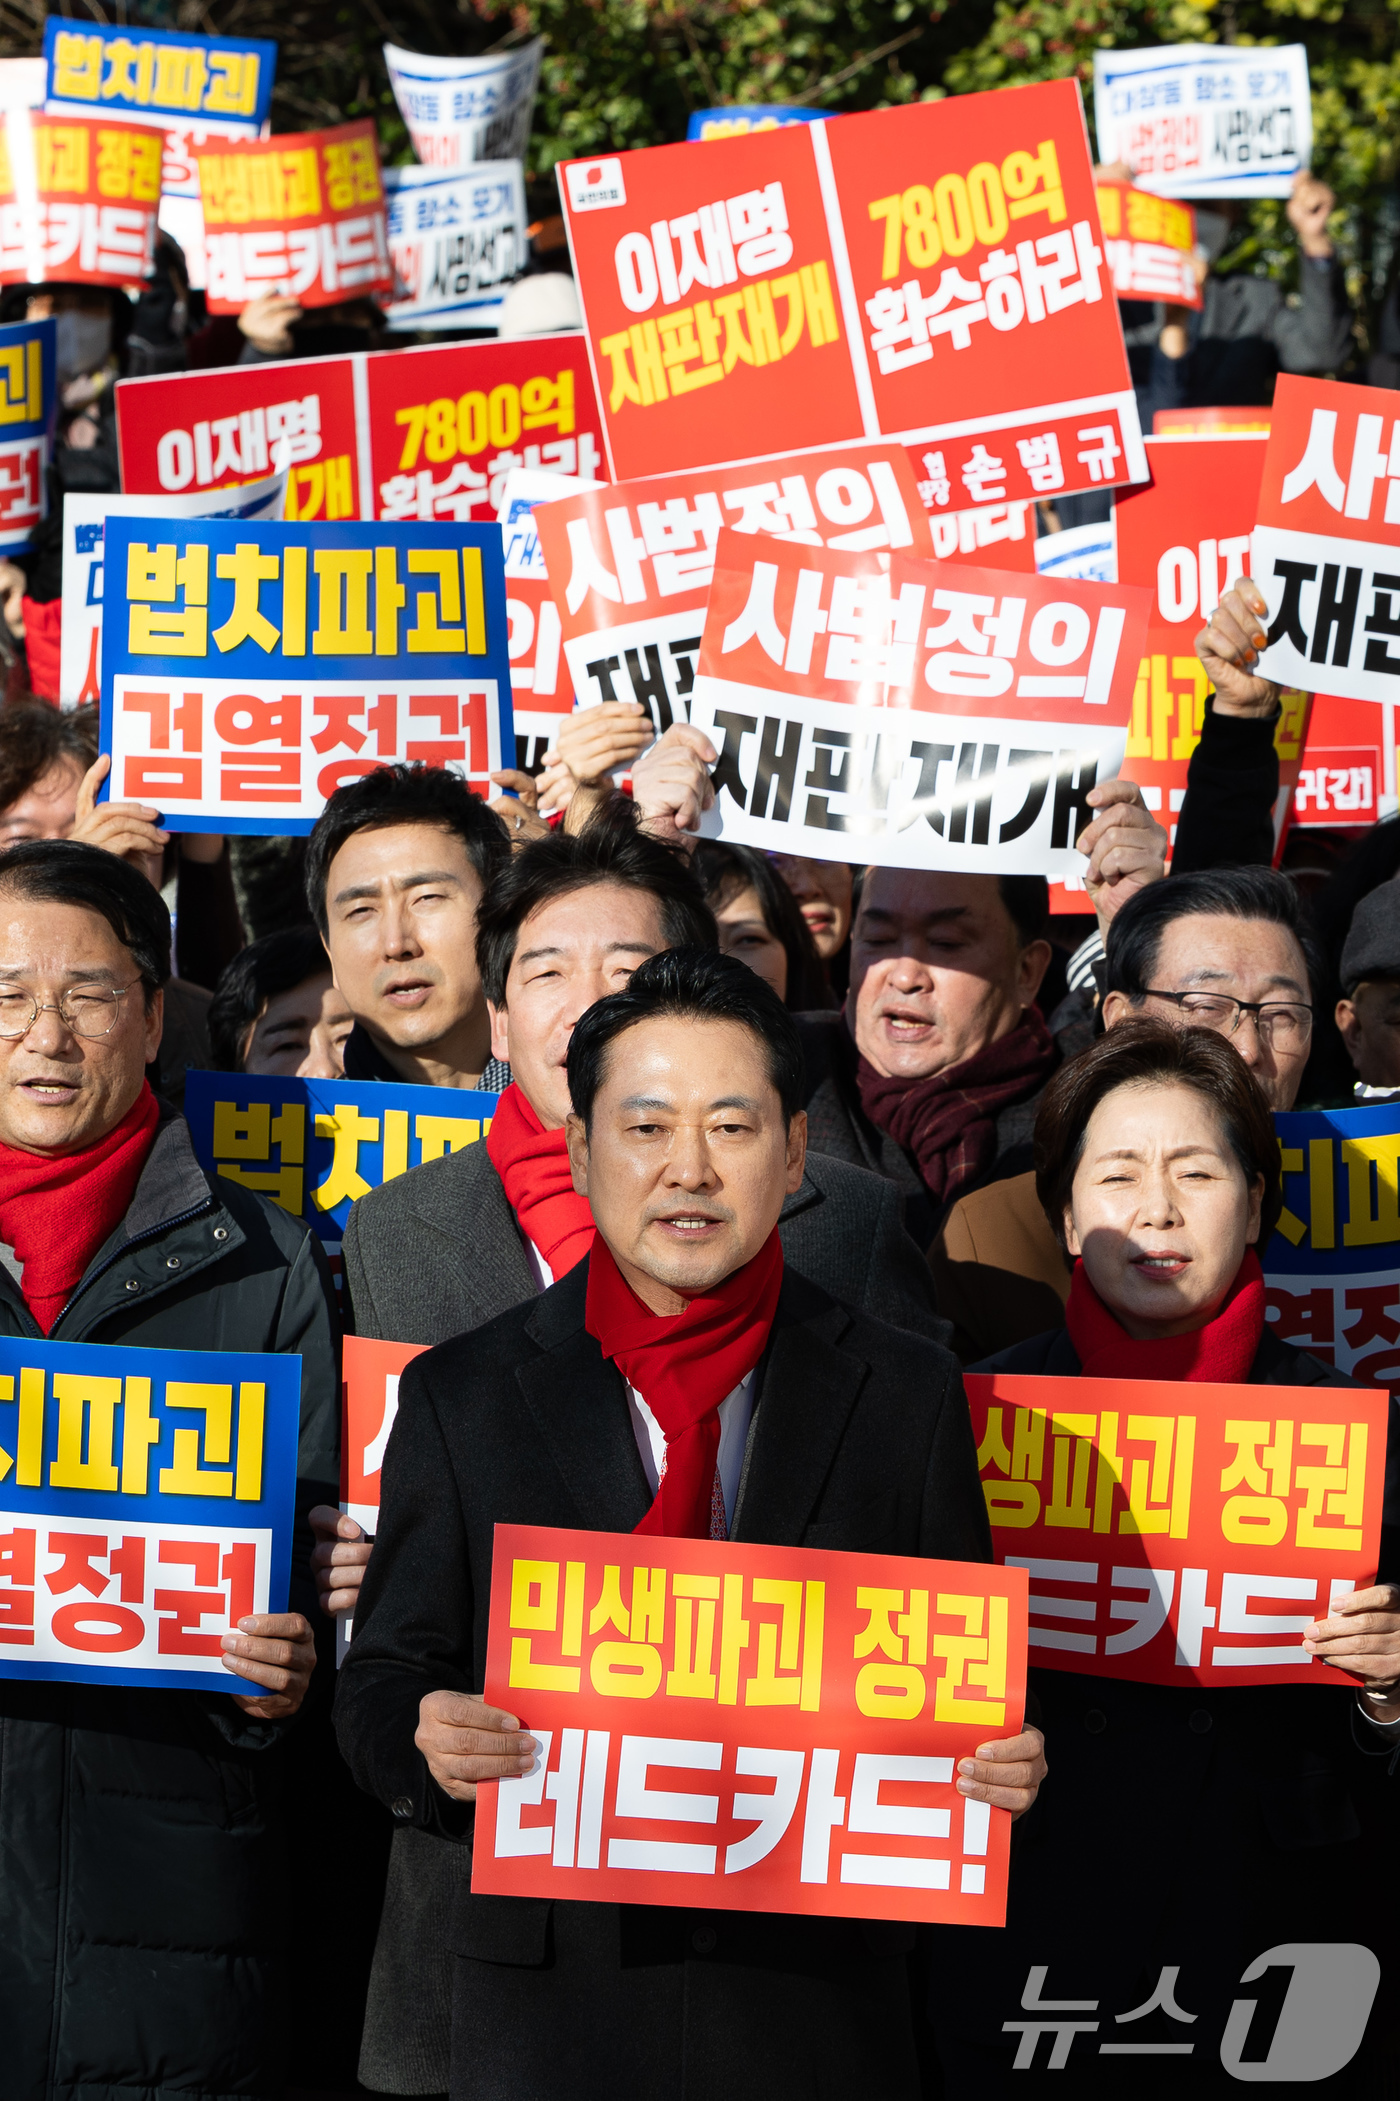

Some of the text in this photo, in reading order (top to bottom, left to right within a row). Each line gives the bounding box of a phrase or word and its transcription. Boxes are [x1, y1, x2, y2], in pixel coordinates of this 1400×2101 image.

[53, 31, 261, 116] 법치파괴
[204, 212, 392, 301] 레드카드!
[614, 181, 794, 313] 이재명
[868, 139, 1068, 280] 7800억
[600, 260, 839, 414] 재판재개
[866, 220, 1103, 375] 환수하라
[157, 395, 322, 491] 이재명
[395, 369, 576, 470] 7800억
[127, 543, 487, 657] 법치파괴
[722, 560, 1126, 705] 사법정의
[121, 690, 490, 803] 검열정권
[712, 709, 1099, 849] 재판재개
[1220, 1419, 1369, 1552] 정권
[508, 1559, 1009, 1726] 민생파괴 정권
[494, 1727, 992, 1895] 레드카드!
